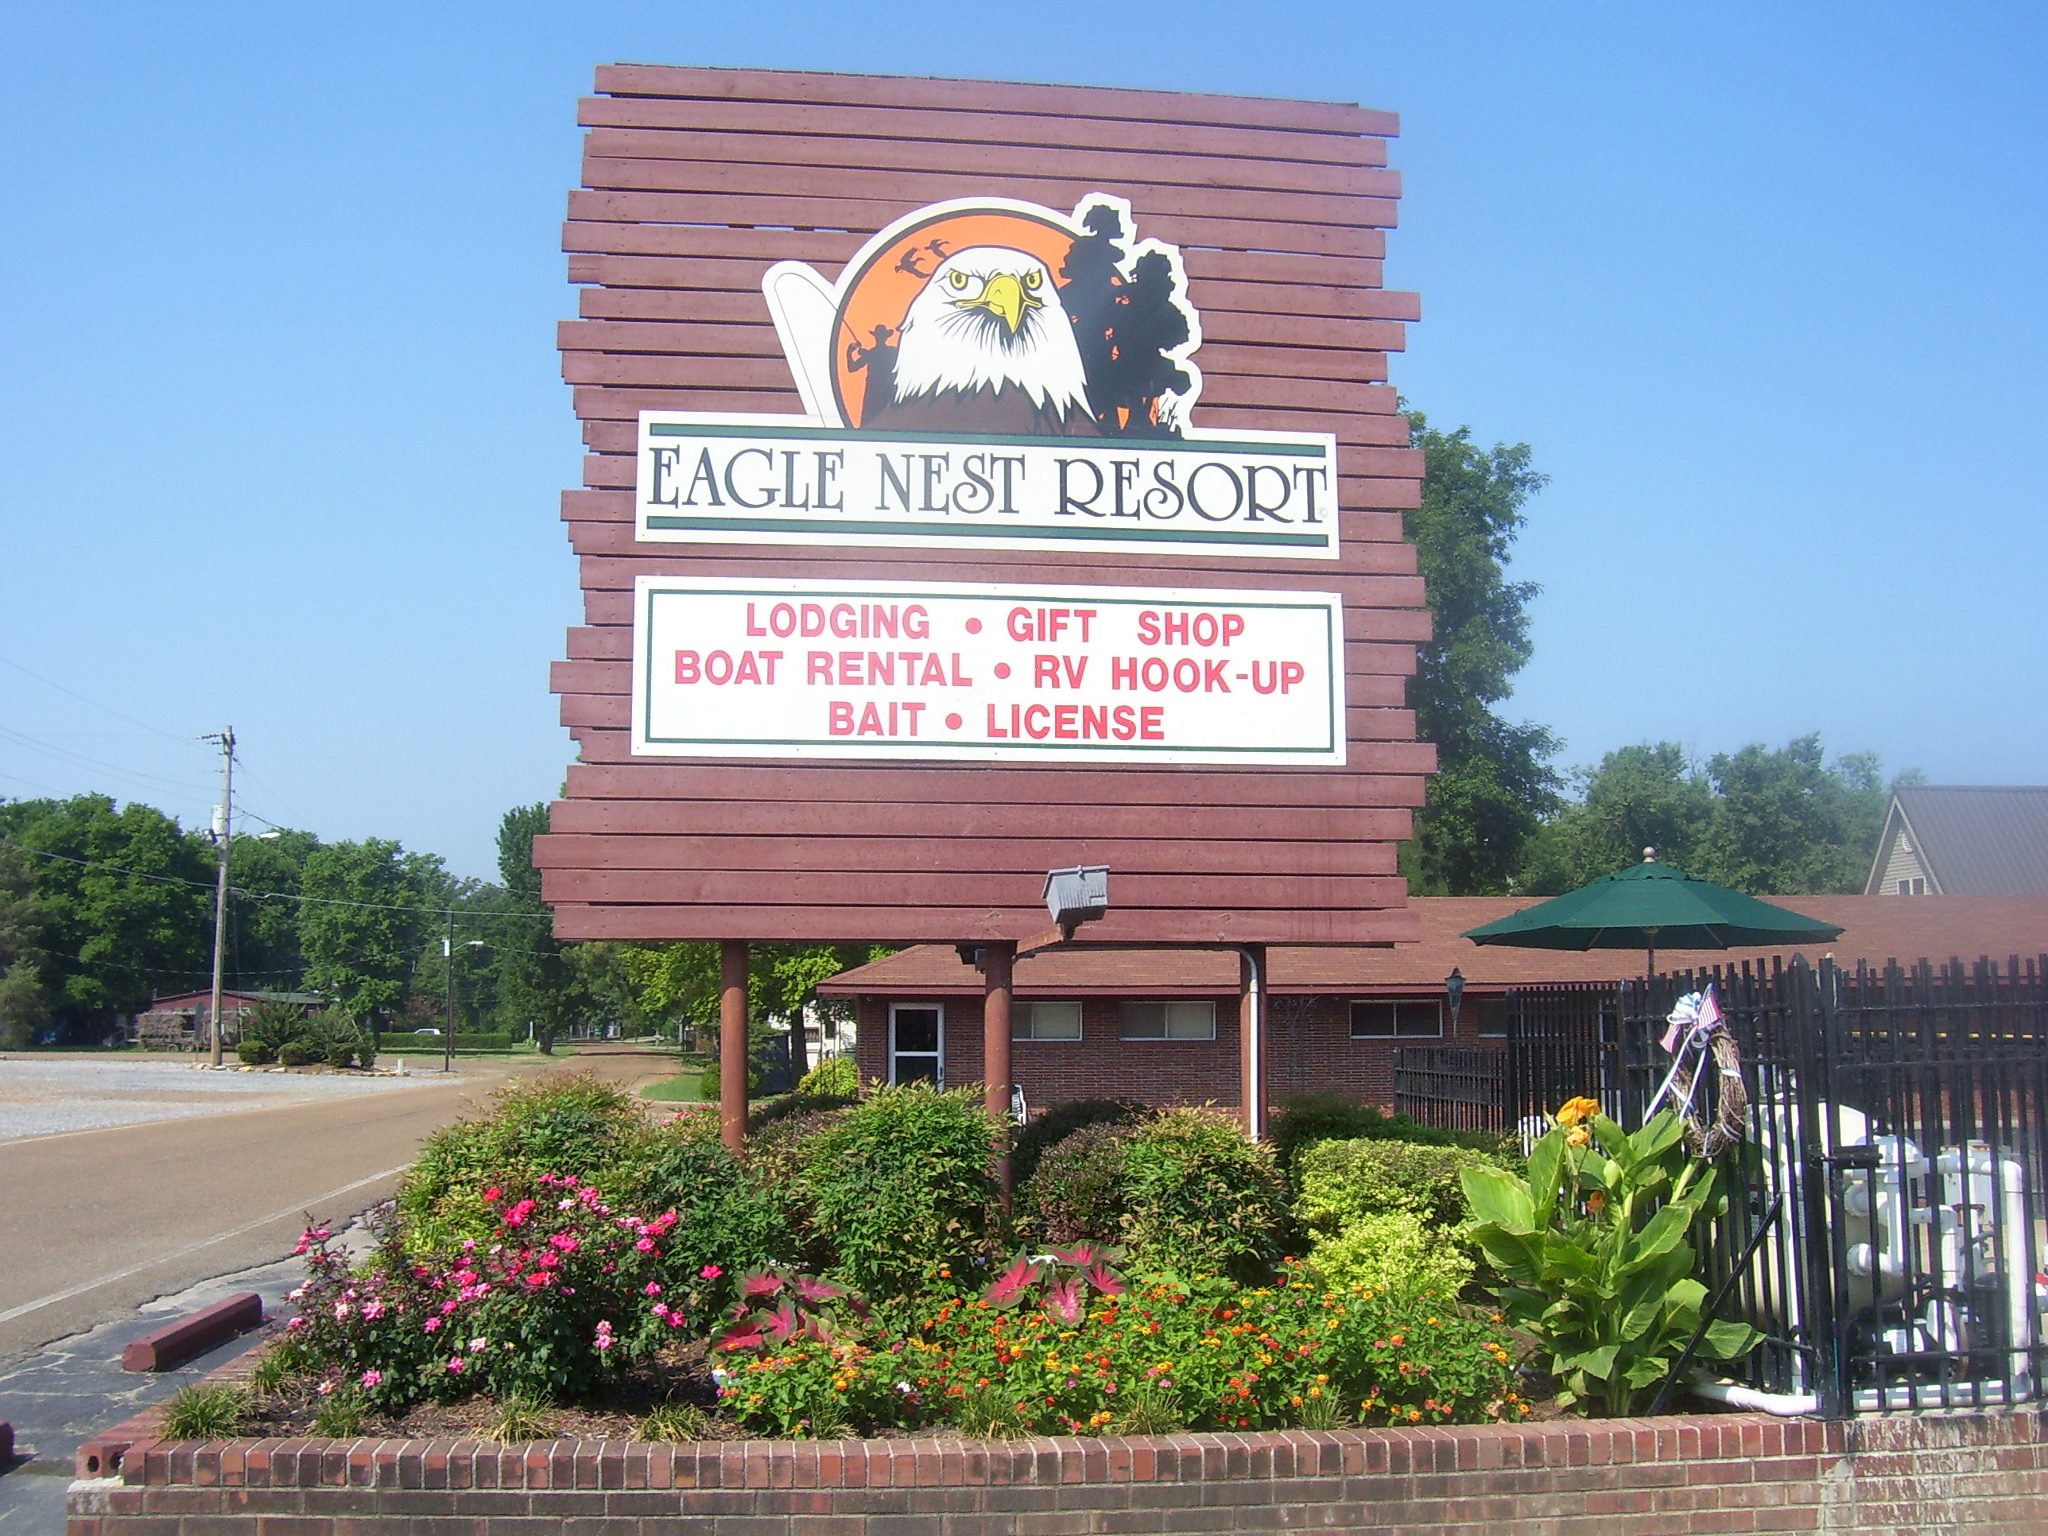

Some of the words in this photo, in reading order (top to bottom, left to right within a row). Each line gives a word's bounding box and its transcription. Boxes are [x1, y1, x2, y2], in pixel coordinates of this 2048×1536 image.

[646, 447, 846, 511] EAGLE
[874, 452, 1027, 515] NEST
[1053, 458, 1328, 524] RESORT
[746, 602, 929, 639] LODGING
[1007, 607, 1098, 643] GIFT
[1137, 610, 1245, 647] SHOP
[674, 650, 784, 686] BOAT
[807, 651, 973, 687] RENTAL
[1034, 655, 1088, 689] RV
[1111, 656, 1305, 694] HOOK-UP
[829, 701, 926, 737] BAIT
[986, 703, 1165, 740] LICENSE
